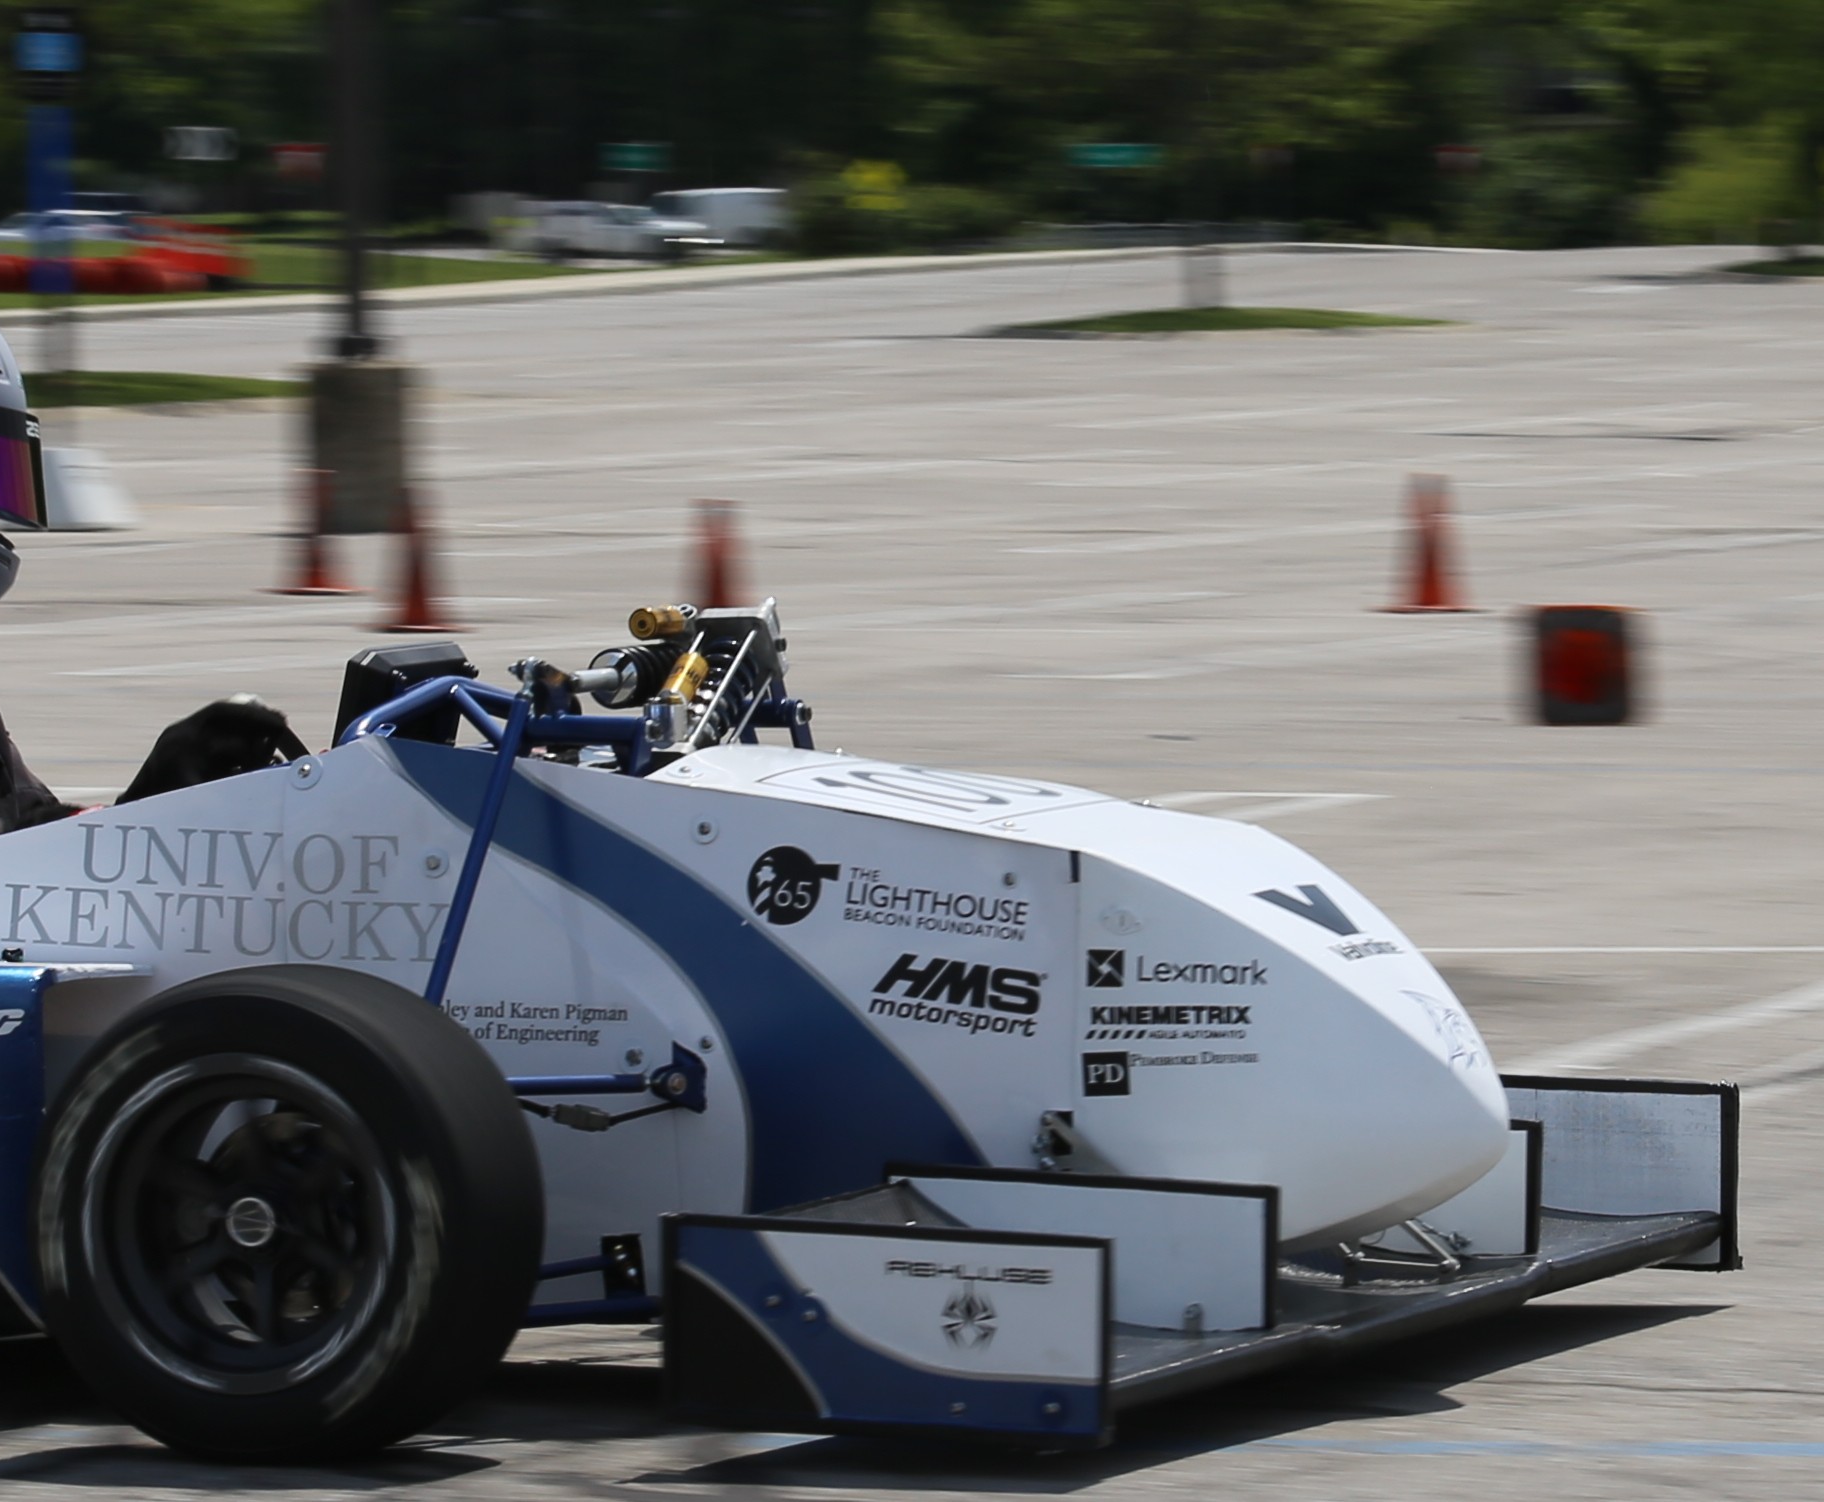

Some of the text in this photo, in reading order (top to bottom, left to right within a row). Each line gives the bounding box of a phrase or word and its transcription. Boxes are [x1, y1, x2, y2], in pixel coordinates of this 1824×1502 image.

[292, 834, 399, 894] OF
[850, 867, 880, 882] THE
[846, 881, 1029, 925] LIGHTHOUSE
[1, 883, 448, 962] KENTUCKY
[844, 907, 1026, 941] BEACON FOUNDATION
[871, 953, 1041, 1015] HMS
[1138, 956, 1267, 985] Lexmark
[475, 1001, 504, 1018] and
[510, 1003, 560, 1019] Karen
[566, 1004, 628, 1024] Pigman
[868, 998, 1038, 1037] motorsport
[1091, 1006, 1252, 1025] KINEMETRIX
[475, 1022, 493, 1039] of
[497, 1024, 600, 1046] Engineering
[1088, 1063, 1124, 1084] PD
